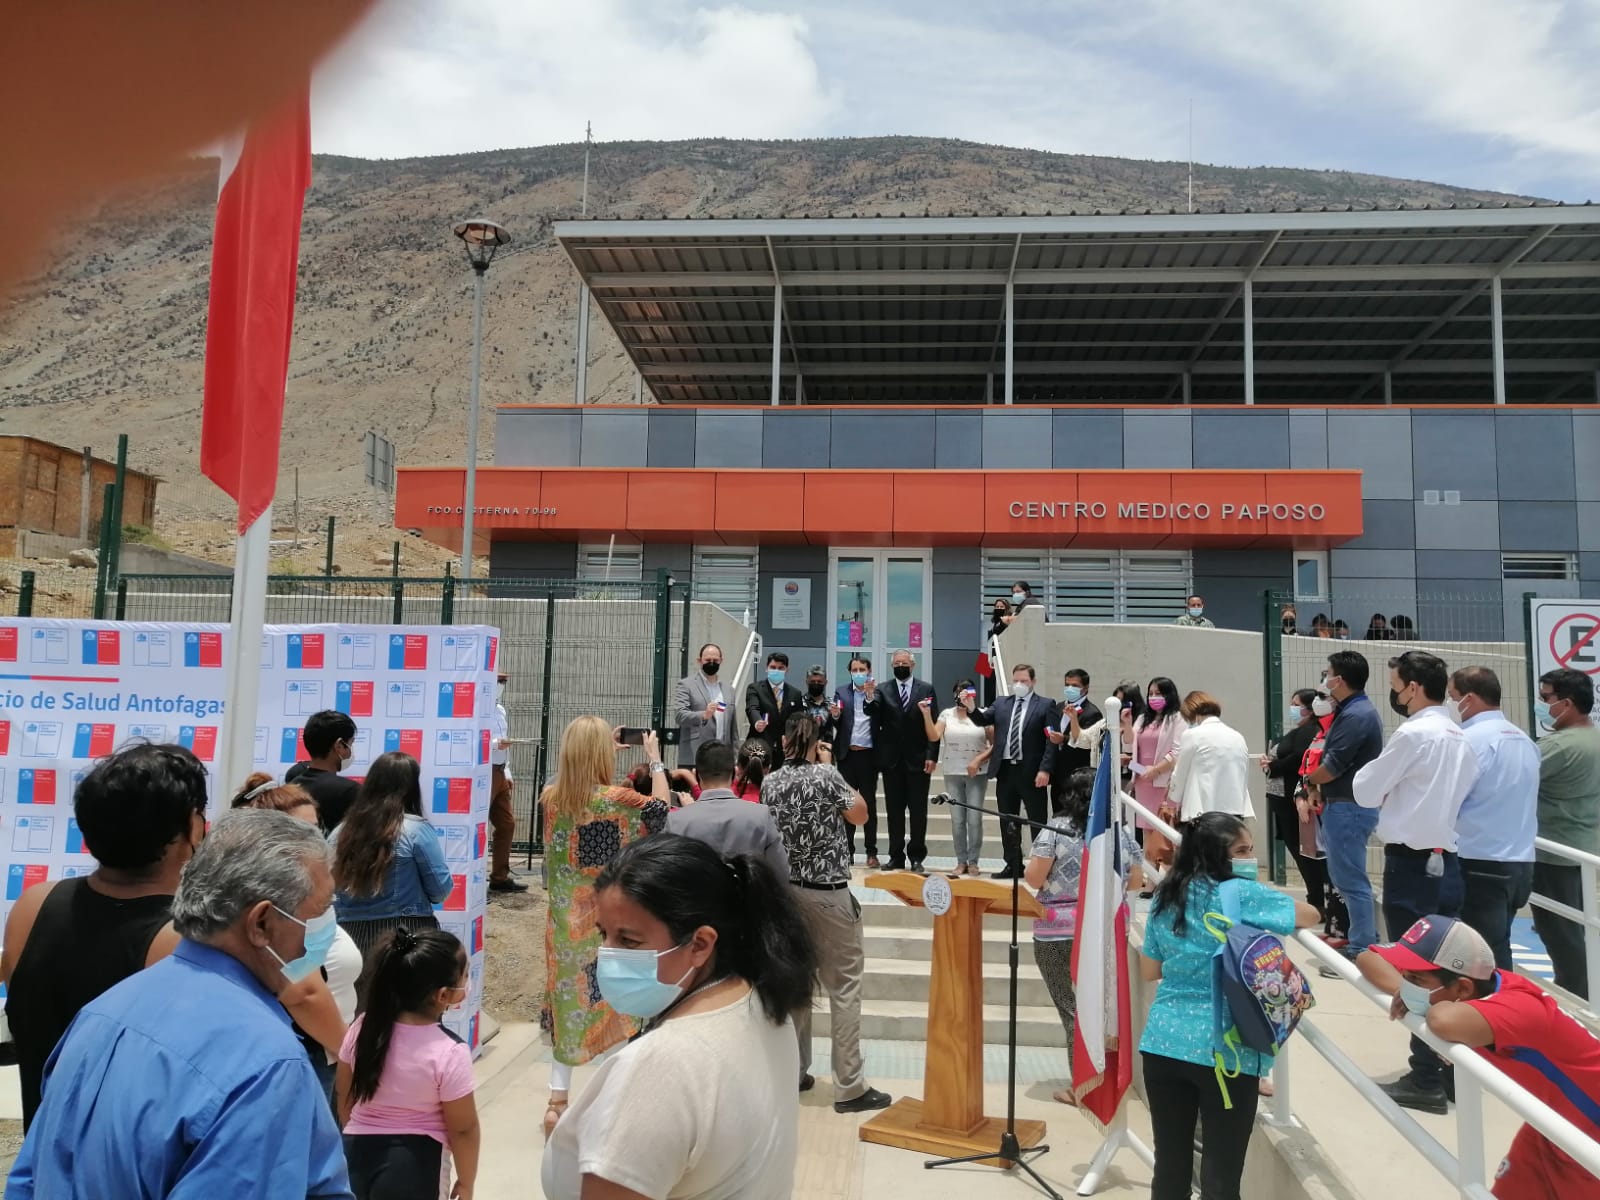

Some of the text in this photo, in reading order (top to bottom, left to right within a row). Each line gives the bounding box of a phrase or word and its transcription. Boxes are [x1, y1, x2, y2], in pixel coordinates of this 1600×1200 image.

[1009, 502, 1325, 520] CENTRO MEDICO PAPOSO
[31, 691, 56, 709] de
[62, 692, 120, 711] Salud
